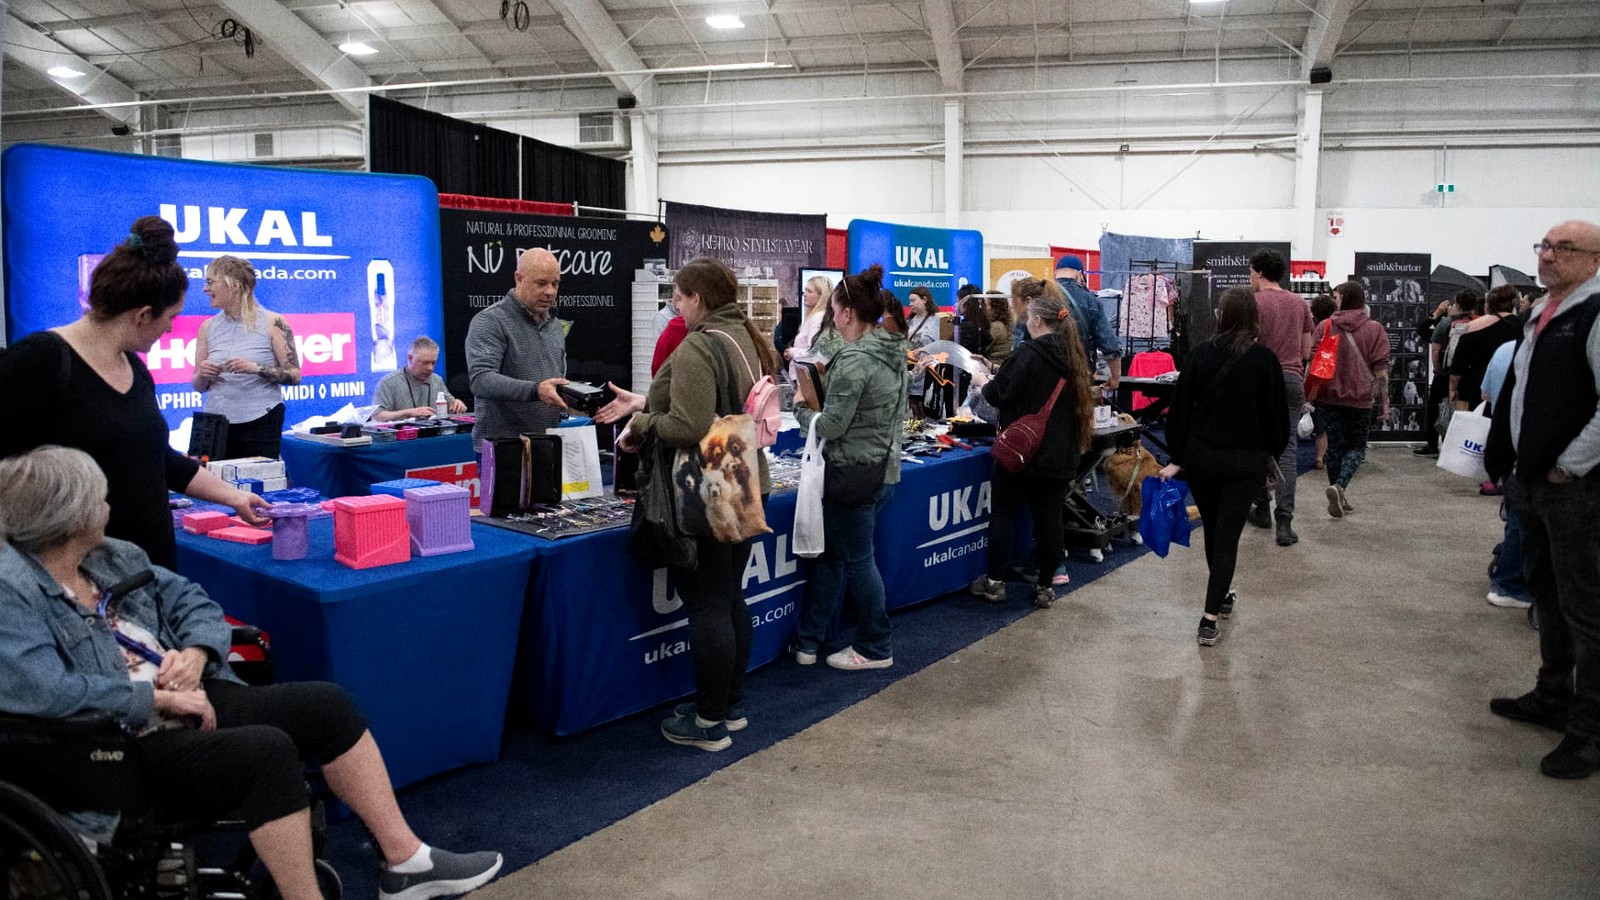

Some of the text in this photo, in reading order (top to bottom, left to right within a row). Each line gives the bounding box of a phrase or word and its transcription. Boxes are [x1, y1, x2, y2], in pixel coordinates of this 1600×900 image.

[159, 203, 333, 247] UKAL
[466, 220, 617, 241] NATURAL & PROFESSIONNAL GROOMING
[701, 233, 814, 254] RETRO STYLIST WEAR
[895, 245, 949, 269] UKAL
[1366, 261, 1422, 272] smith&burton
[894, 280, 950, 289] ukalcanada.com
[559, 295, 615, 307] PROFESSIONNEL
[281, 381, 365, 401] MIDI MINI
[929, 480, 992, 531] UKA
